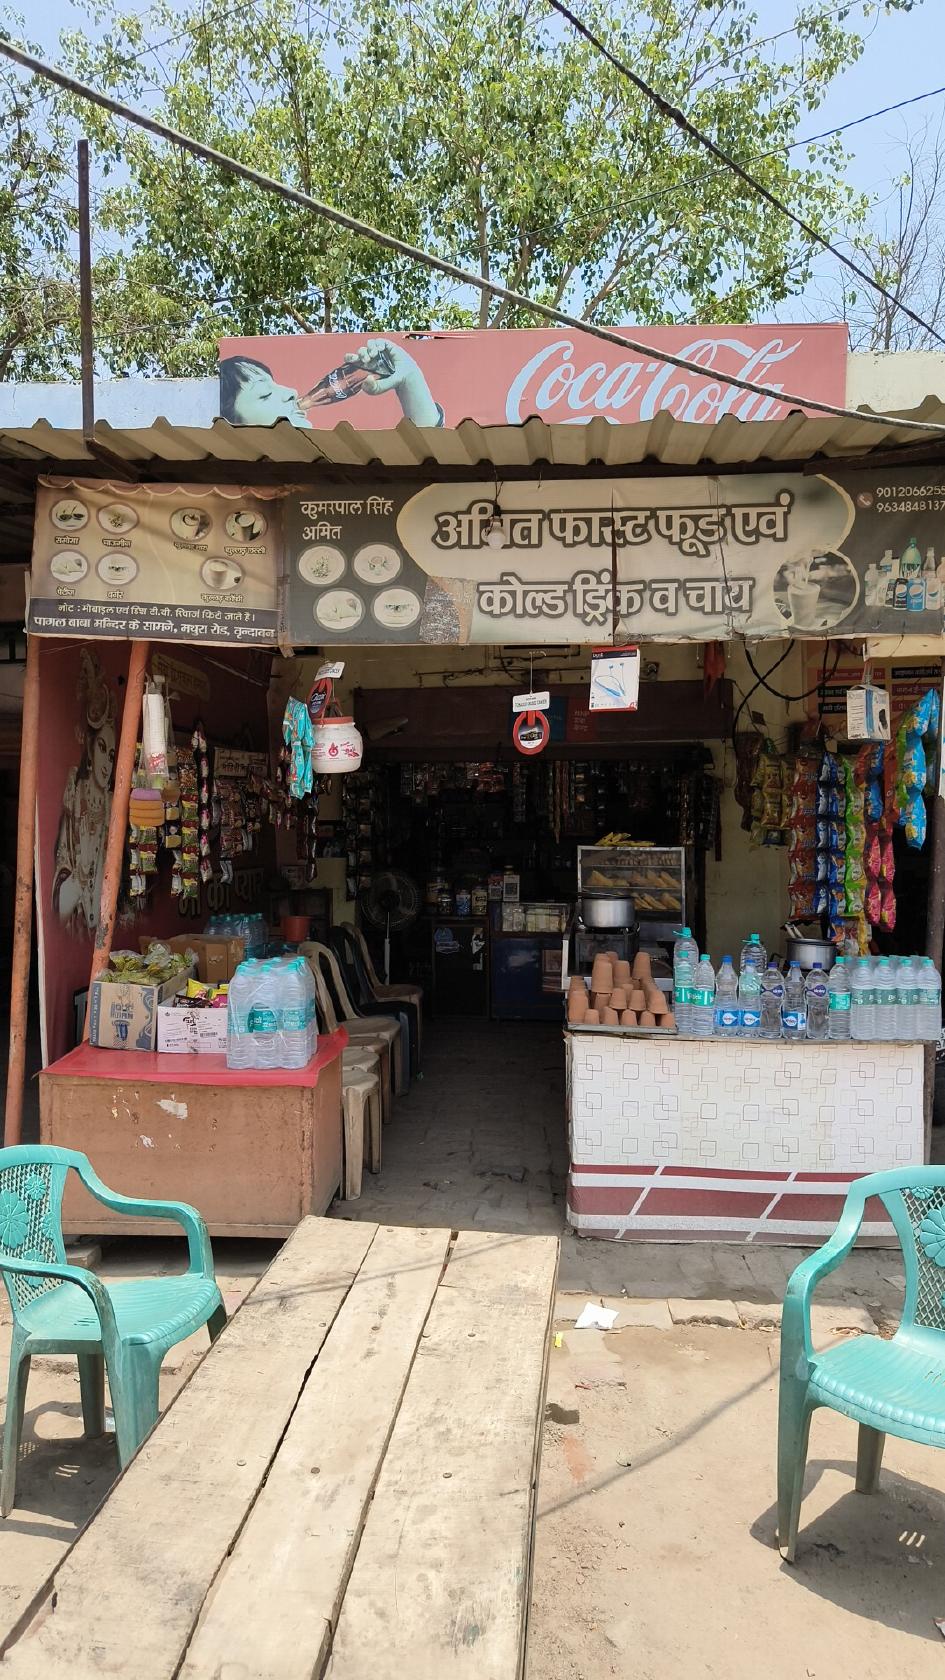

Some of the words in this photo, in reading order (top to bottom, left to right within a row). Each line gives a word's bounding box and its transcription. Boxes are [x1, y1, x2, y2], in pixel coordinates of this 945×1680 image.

[505, 338, 803, 424] Coca-Cola
[876, 486, 945, 498] 9012066255
[300, 500, 364, 519] कुमरपाल
[366, 496, 394, 515] सिंह
[876, 500, 945, 513] 9634848137
[302, 521, 343, 541] अमित
[549, 508, 651, 548] फास्ट
[654, 506, 727, 557] फूड
[729, 488, 794, 544] एवं
[55, 536, 80, 545] समोसा
[476, 571, 570, 618] कोल्ड
[571, 568, 644, 627] ड्रिंक
[648, 578, 682, 616] व
[683, 576, 756, 617] चाय
[58, 603, 74, 613] नोट
[82, 603, 114, 616] मोबाइल
[115, 605, 130, 615] एवं
[224, 611, 242, 621] जाते
[33, 616, 66, 628] पागल
[67, 618, 91, 628] बाबा
[93, 617, 127, 630] मन्दिर
[128, 619, 140, 630] के
[142, 619, 178, 633] सामने,
[180, 623, 208, 636] मथुरा
[210, 623, 231, 636] रोड,
[233, 626, 275, 639] वृन्दावन
